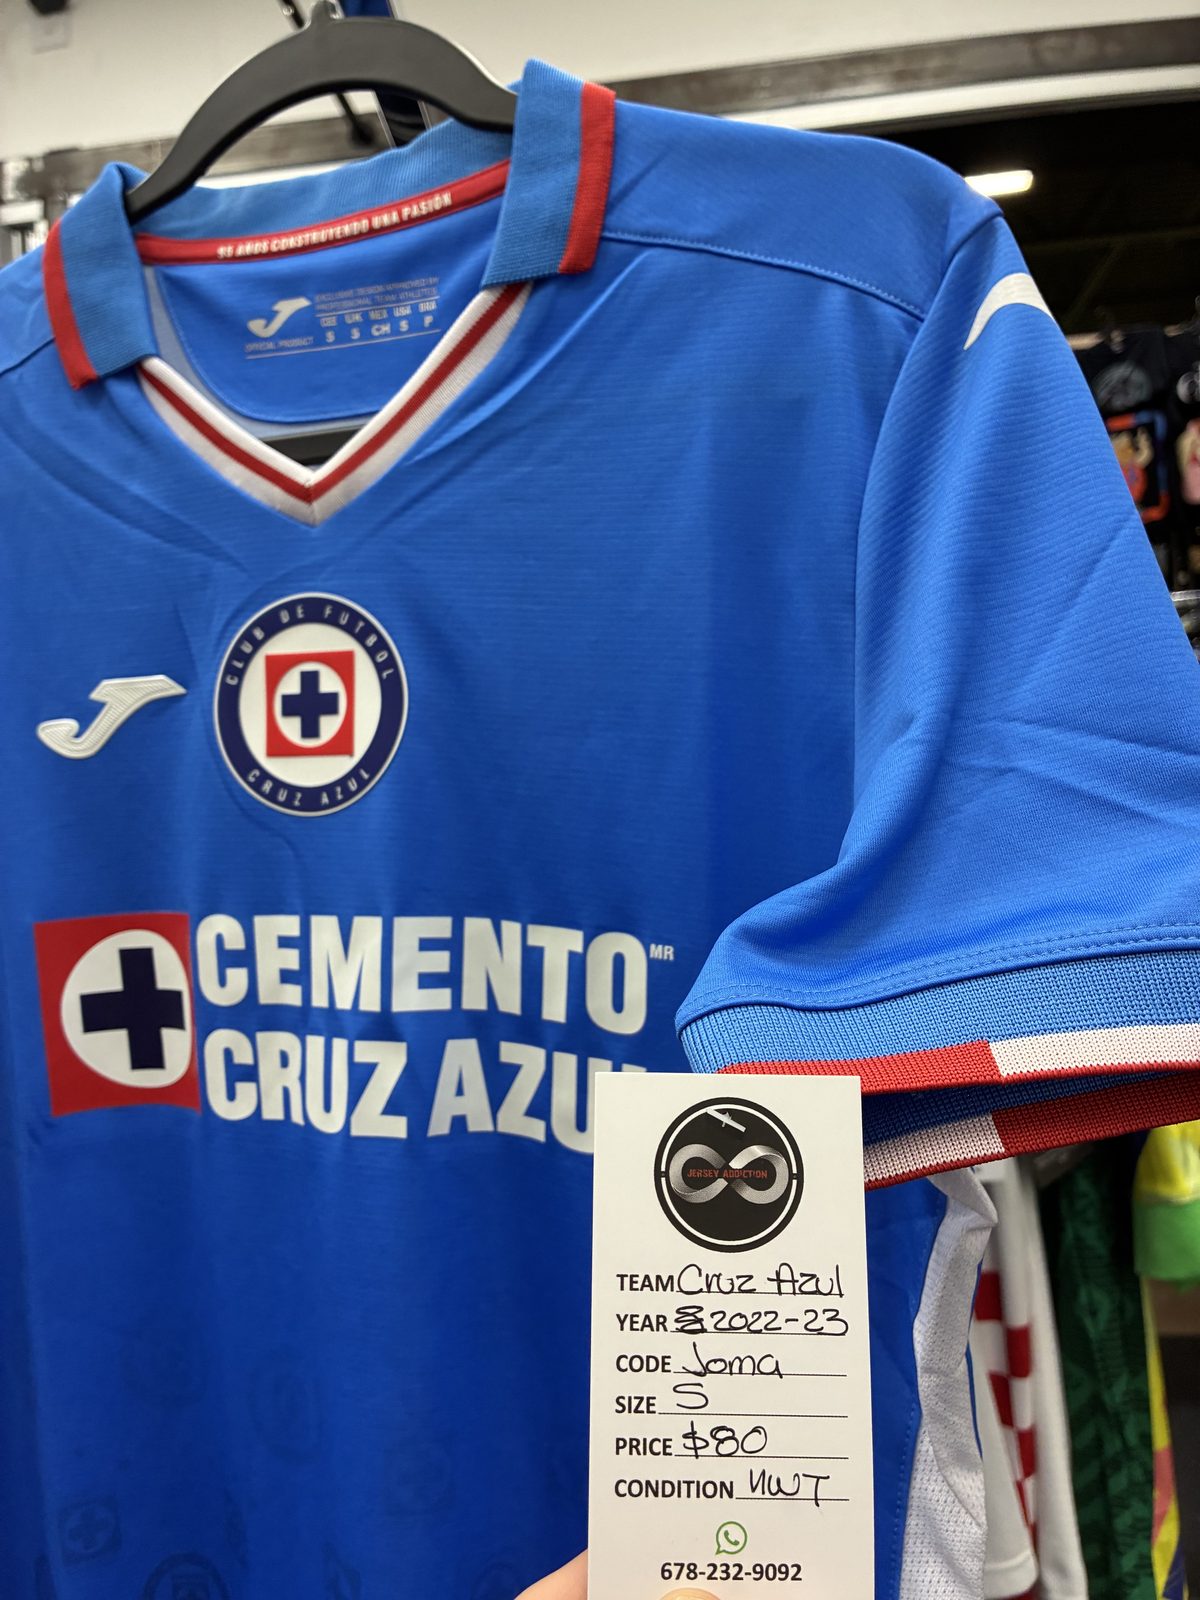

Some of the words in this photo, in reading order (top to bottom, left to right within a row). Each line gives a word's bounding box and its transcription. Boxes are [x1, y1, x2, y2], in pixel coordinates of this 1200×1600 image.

[270, 218, 369, 253] CONSTRUYENDO
[371, 208, 400, 230] UNA
[401, 191, 452, 221] PASIÓN
[326, 330, 335, 343] S
[351, 327, 360, 339] S
[371, 322, 391, 336] CH
[400, 319, 409, 331] S
[424, 314, 434, 327] P
[225, 626, 265, 686] CLUB
[279, 604, 305, 624] DE
[324, 604, 394, 680] FUTBOL
[247, 768, 302, 806] CRUZ
[320, 768, 370, 806] AZUL
[196, 913, 648, 1036] CEMENTO
[649, 943, 674, 961] MR
[204, 1028, 408, 1139] CRUZ
[427, 1038, 647, 1154] AZU
[687, 1168, 719, 1179] JERSEY
[722, 1168, 768, 1180] ADDICTION
[616, 1273, 675, 1292] TEAM
[677, 1263, 757, 1295] Cruz
[767, 1262, 844, 1298] Azul
[616, 1313, 668, 1332] YEAR
[710, 1308, 849, 1336] 2022-23
[616, 1355, 671, 1374] CODE
[682, 1341, 783, 1379] Joma
[615, 1395, 657, 1414] SIZE
[672, 1383, 709, 1409] S
[615, 1437, 673, 1456] PRICE
[682, 1420, 768, 1459] $80
[614, 1479, 734, 1499] CONDITION
[660, 1562, 802, 1581] 678-232-9092
